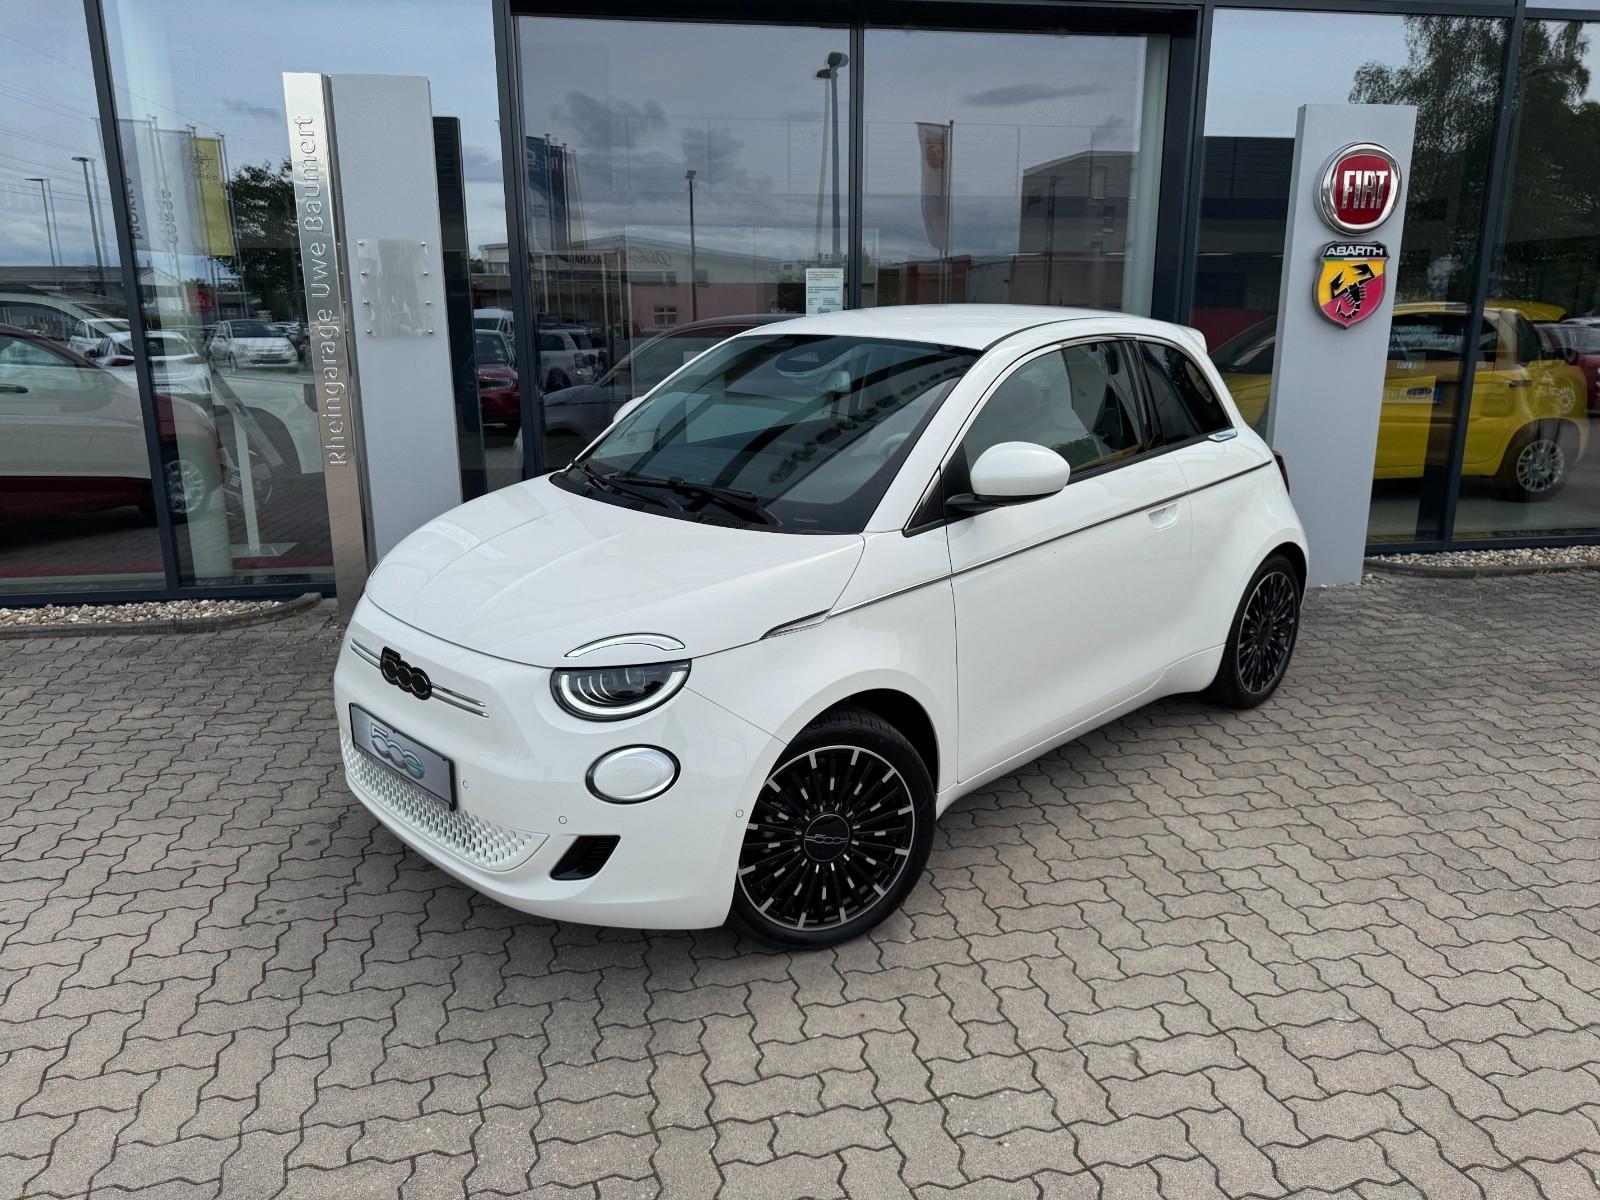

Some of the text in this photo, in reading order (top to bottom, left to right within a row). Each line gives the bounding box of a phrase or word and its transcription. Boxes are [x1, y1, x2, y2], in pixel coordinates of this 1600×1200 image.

[1341, 170, 1389, 209] FIAT
[1326, 245, 1383, 256] ABARTH
[293, 115, 347, 466] Rheingarage Uwe Baumert
[379, 645, 433, 701] 500
[814, 833, 842, 845] 500
